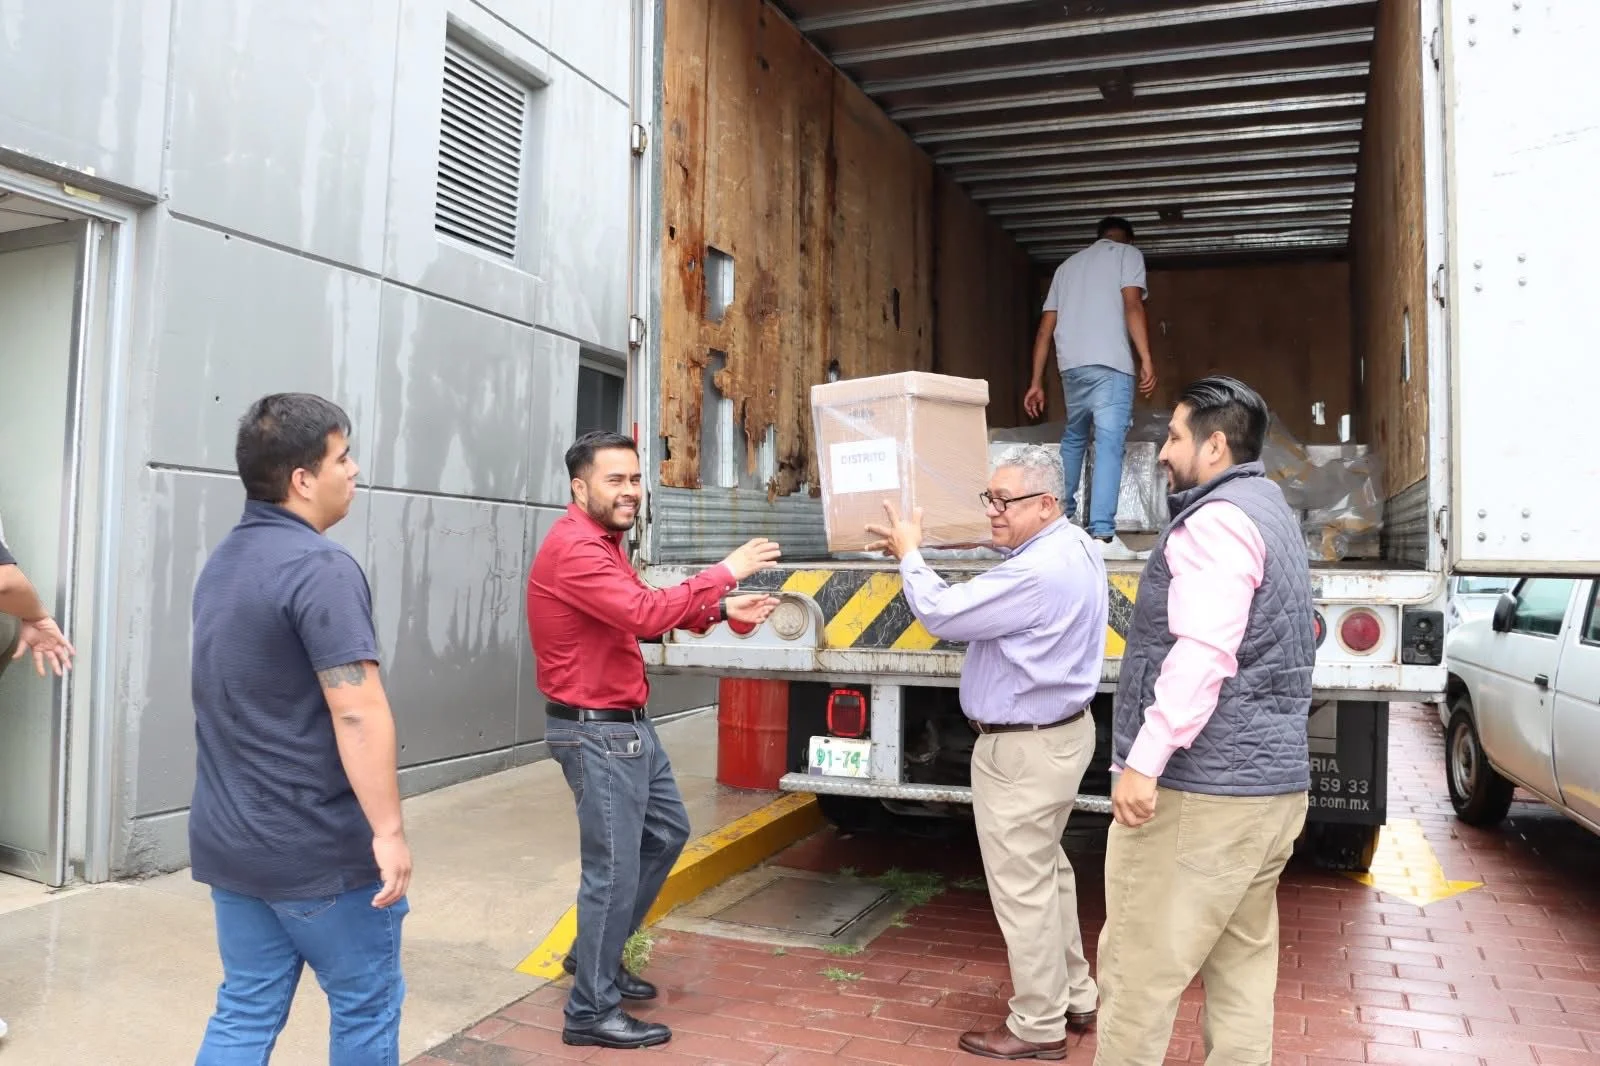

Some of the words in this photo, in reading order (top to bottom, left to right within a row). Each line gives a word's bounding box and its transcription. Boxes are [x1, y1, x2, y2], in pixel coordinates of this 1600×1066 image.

[841, 452, 886, 465] DISTRITO
[868, 473, 873, 482] 1
[1319, 777, 1341, 793] 59
[1348, 779, 1369, 795] 33
